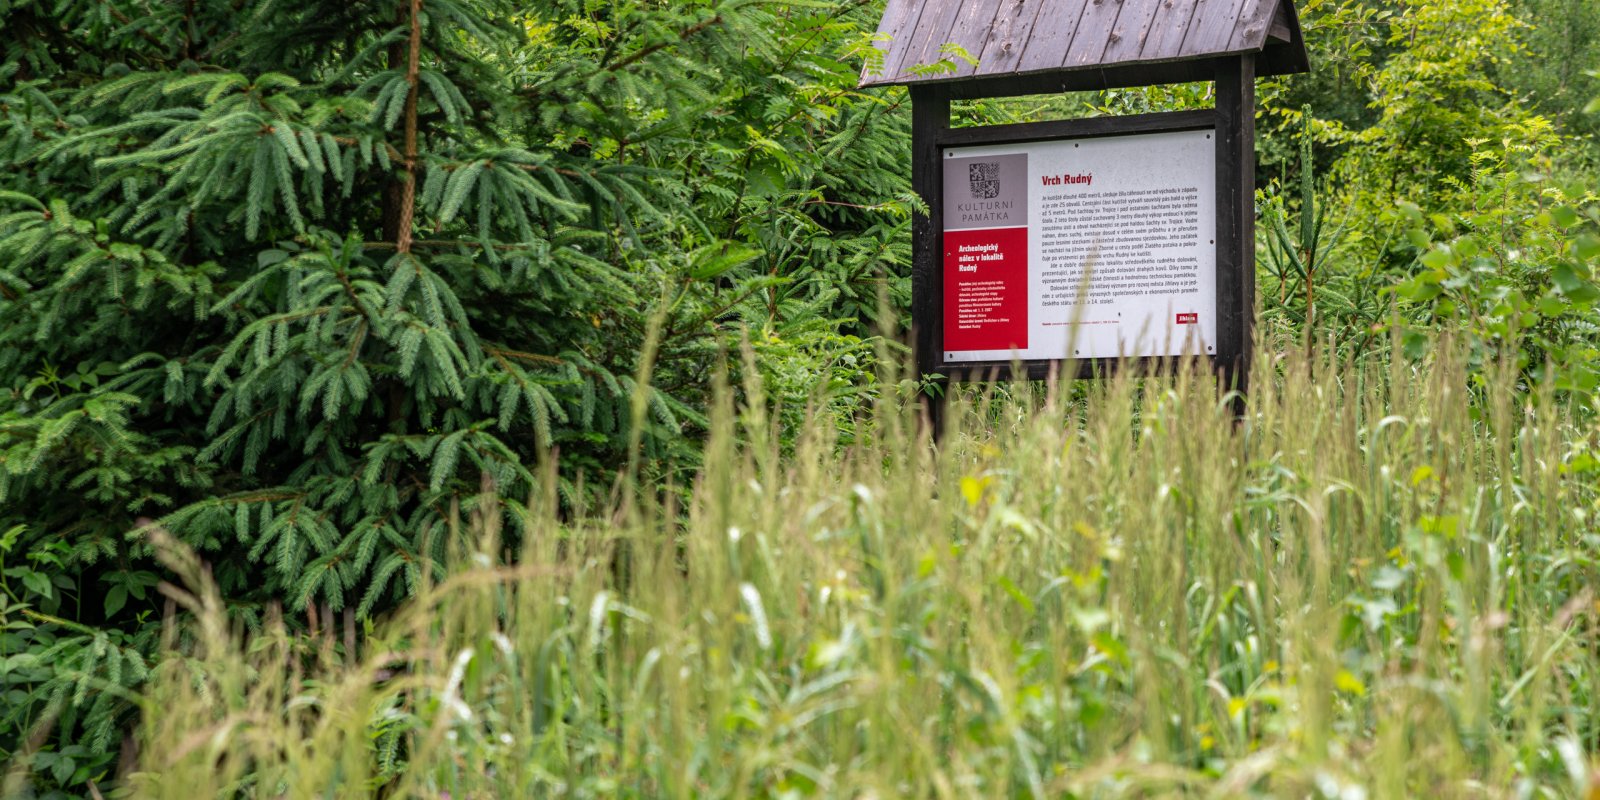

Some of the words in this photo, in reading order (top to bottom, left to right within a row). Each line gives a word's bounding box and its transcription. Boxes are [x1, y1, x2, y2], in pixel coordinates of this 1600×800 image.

[1042, 175, 1061, 186] Vrch
[1064, 172, 1092, 186] Rudný
[958, 198, 1013, 211] KULTURNÍ
[962, 211, 1009, 222] PAMÁTKA
[959, 243, 998, 253] Archeologický
[959, 254, 975, 262] nález
[981, 253, 1004, 261] lokalitě
[959, 264, 977, 273] Rudný
